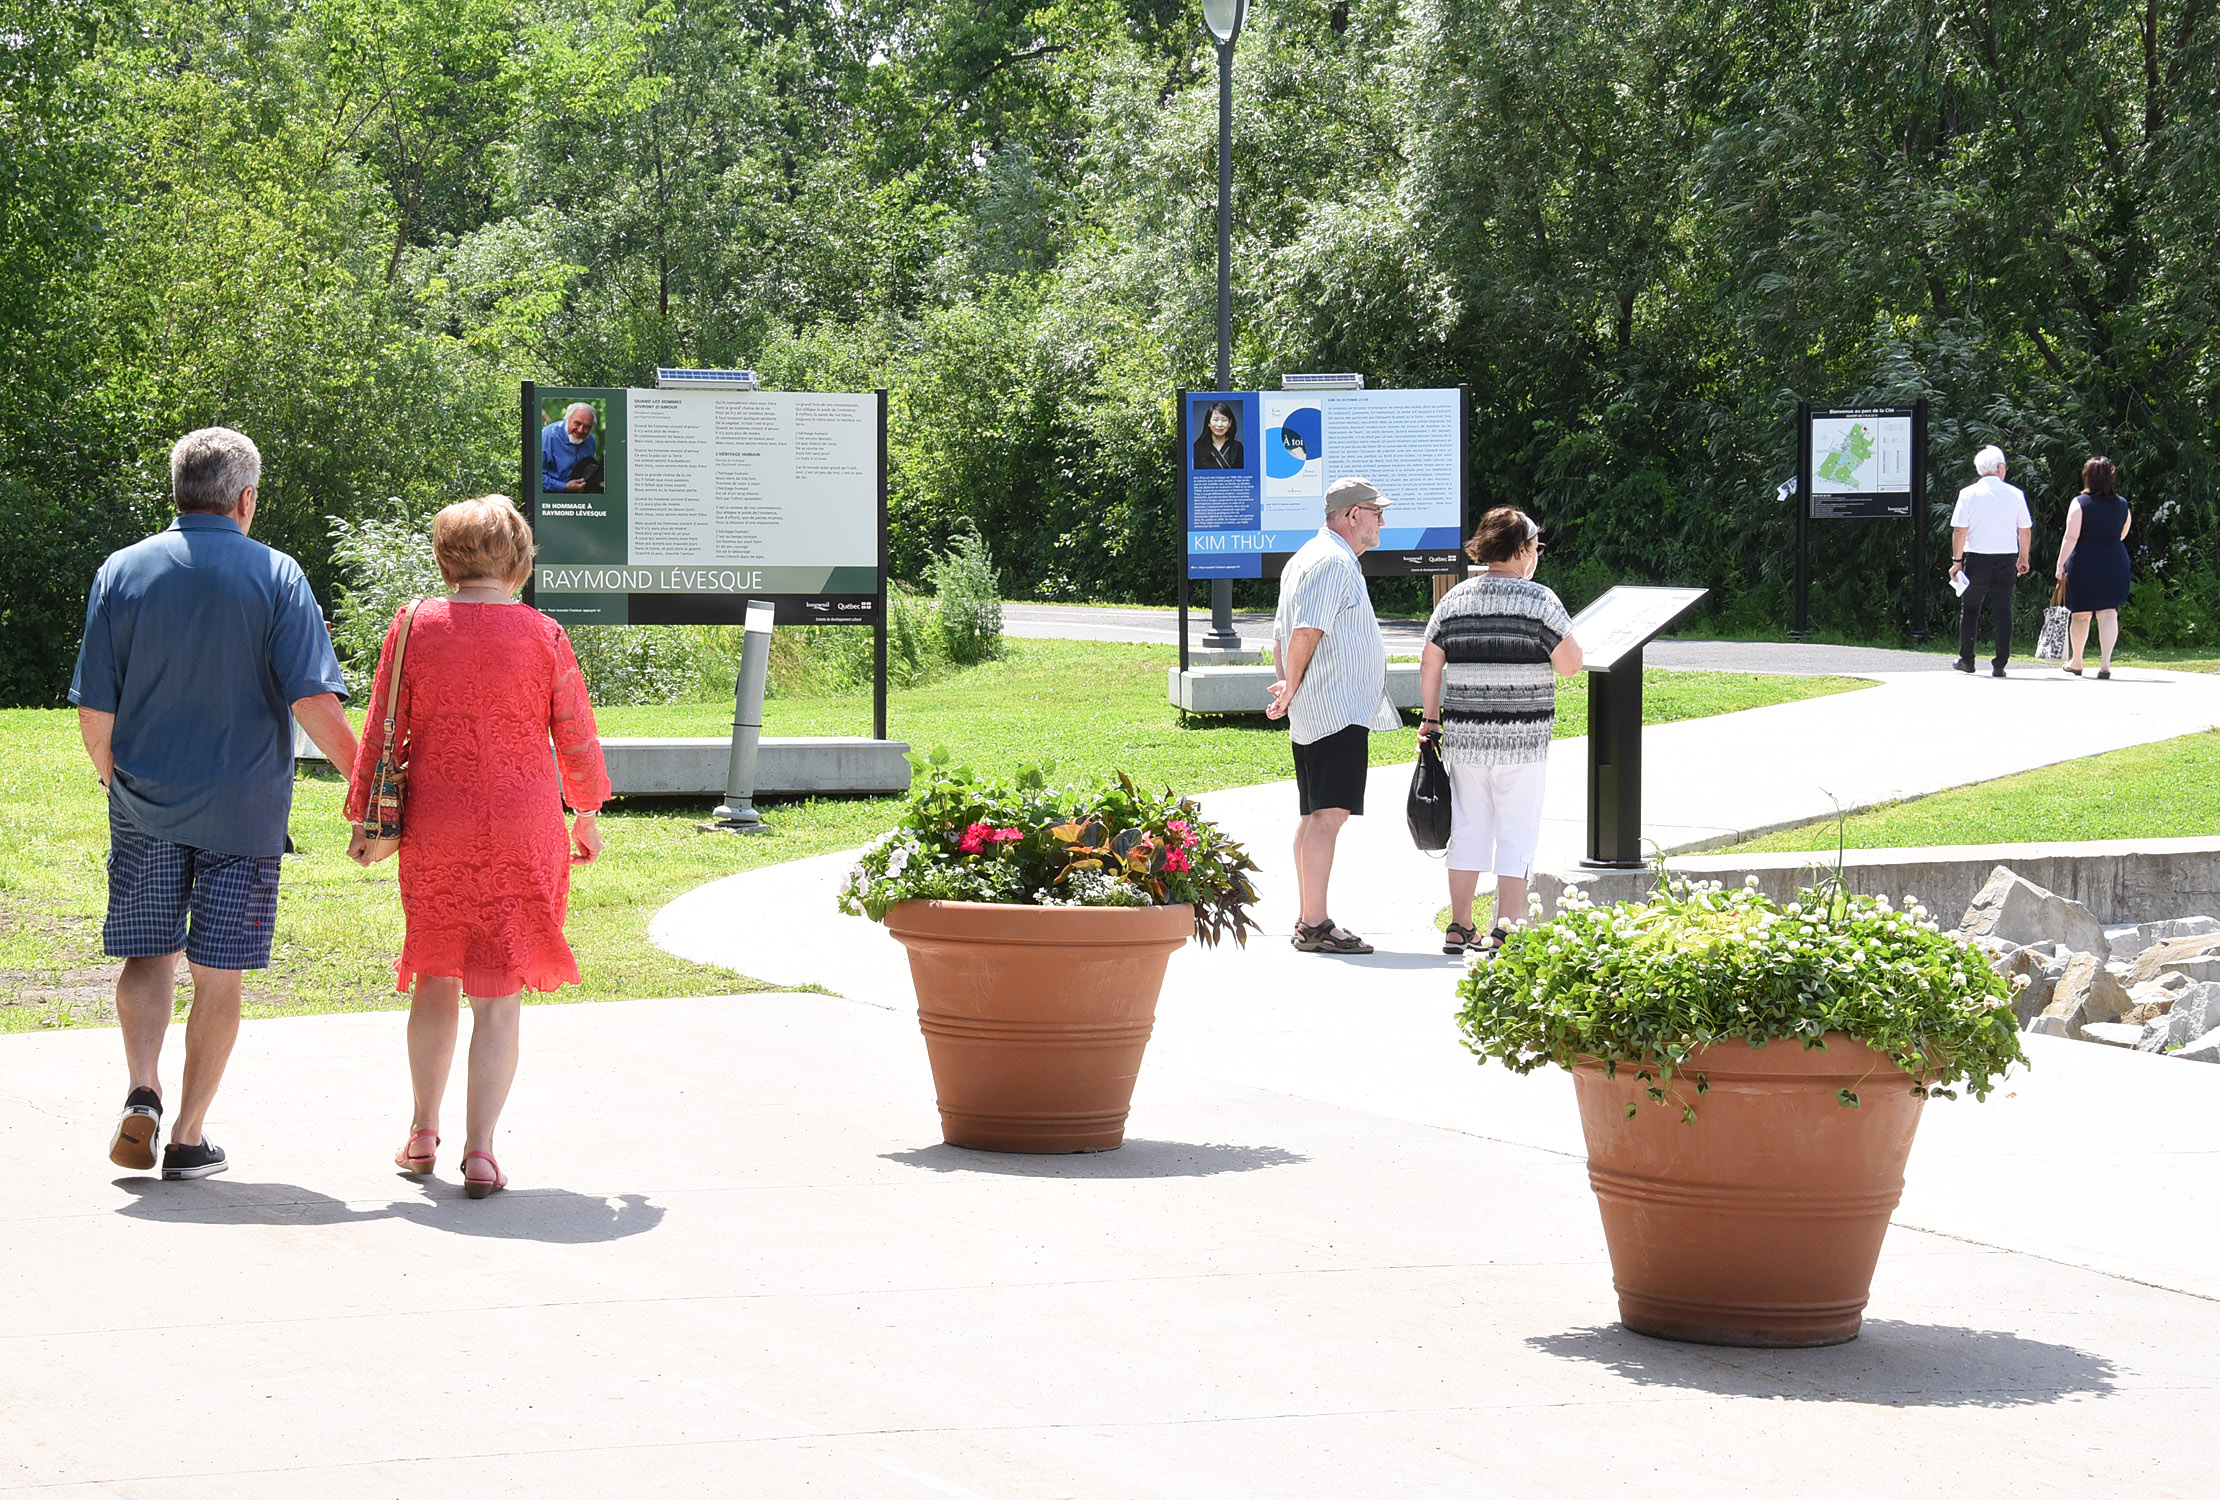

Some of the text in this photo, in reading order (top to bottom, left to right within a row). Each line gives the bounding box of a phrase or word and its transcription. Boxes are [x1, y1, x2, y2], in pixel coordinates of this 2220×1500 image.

[1284, 434, 1304, 446] À toi
[576, 509, 607, 517] LÉVESQUE
[1194, 531, 1277, 550] KIM THÚY
[543, 567, 762, 592] RAYMOND LÉVESQUE
[837, 602, 860, 610] Québec
